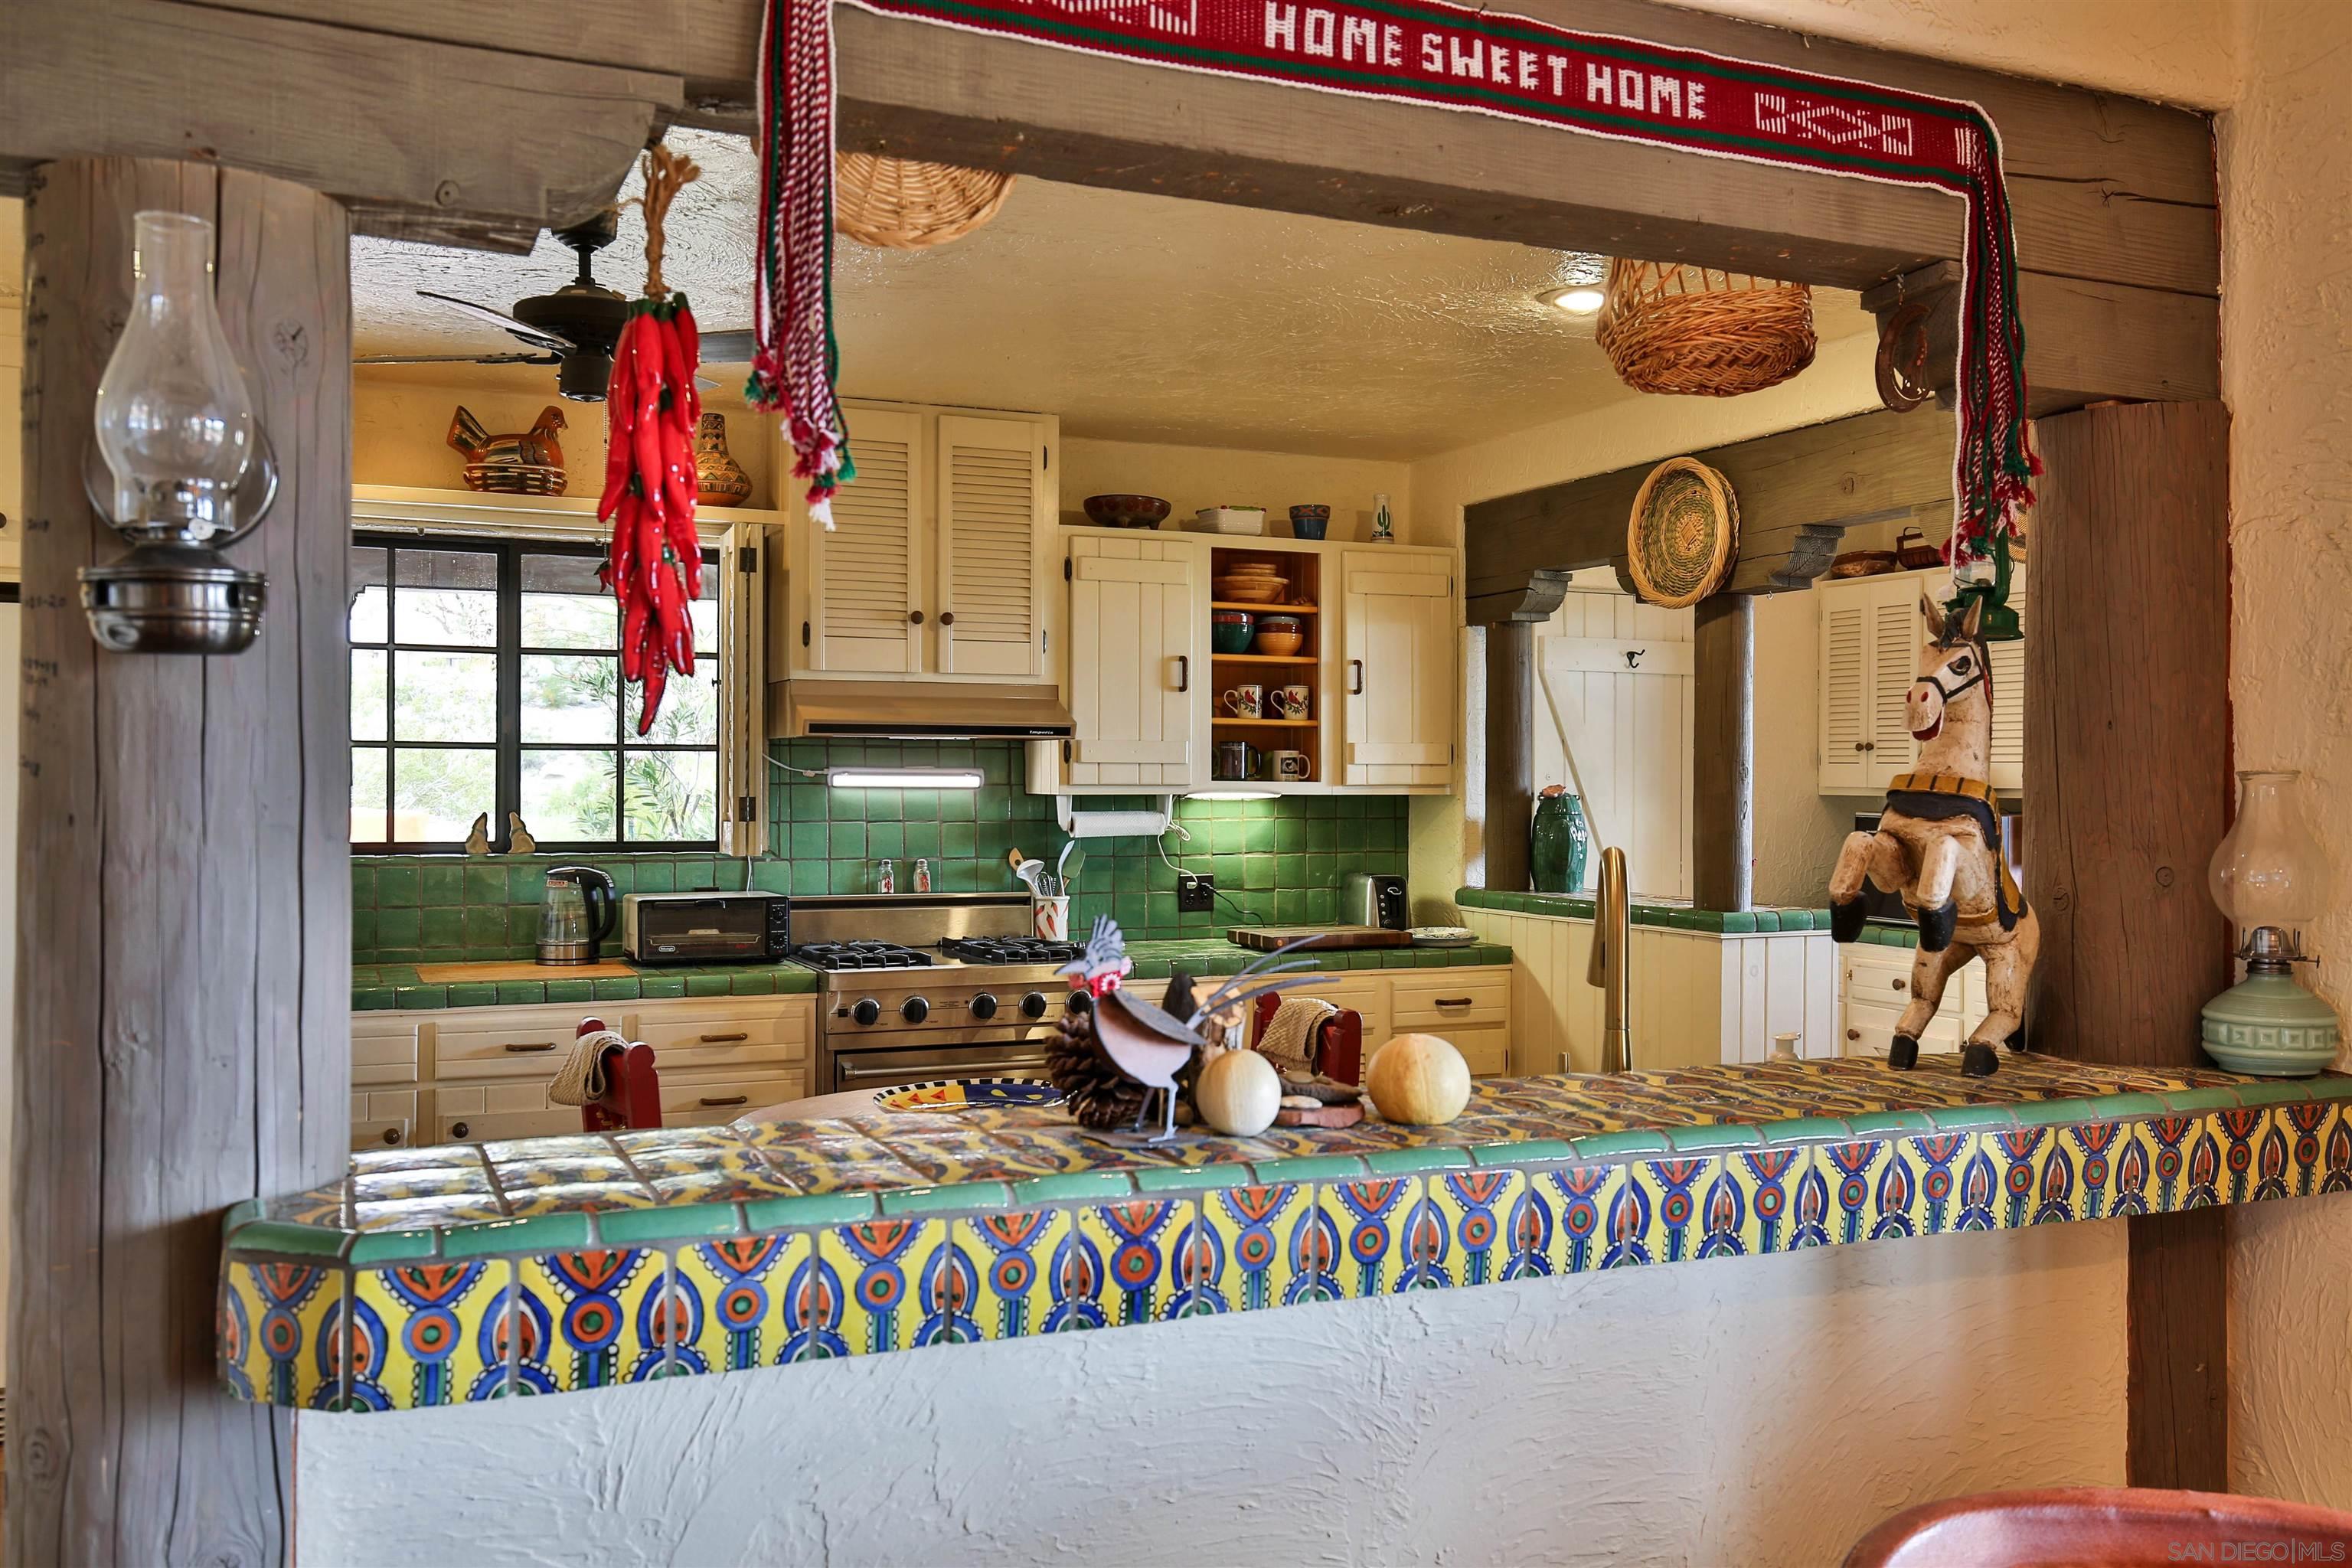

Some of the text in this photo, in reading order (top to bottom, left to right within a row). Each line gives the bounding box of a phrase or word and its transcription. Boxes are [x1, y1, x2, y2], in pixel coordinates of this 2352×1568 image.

[1265, 0, 1706, 119] HOME SWEET HOME
